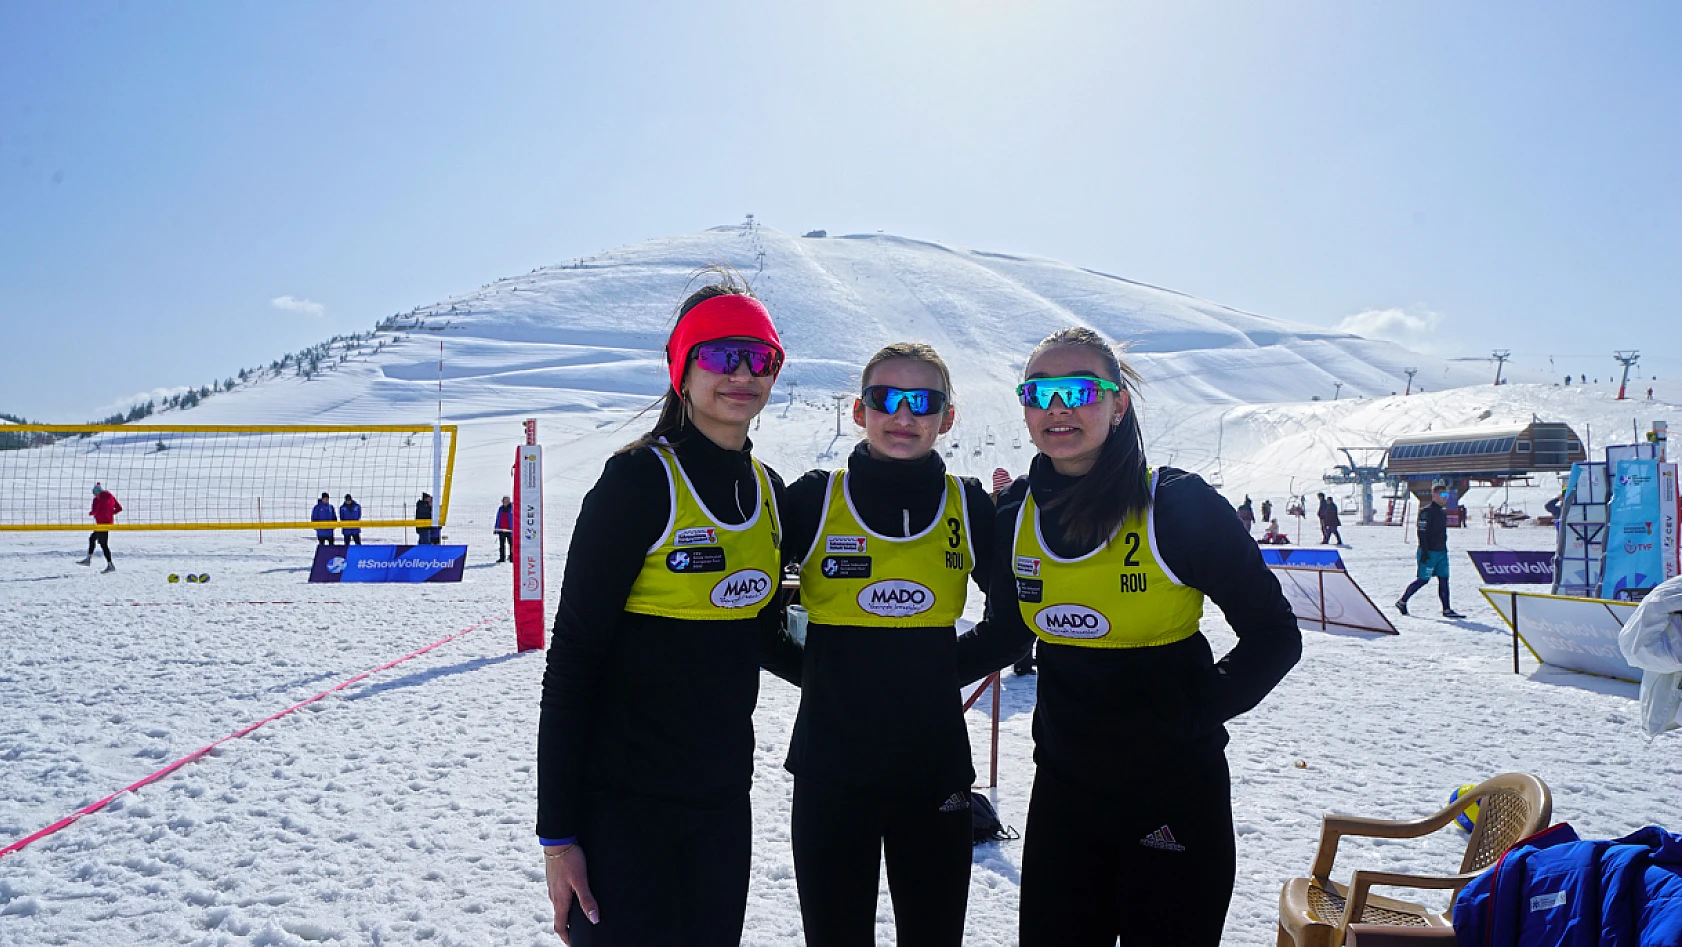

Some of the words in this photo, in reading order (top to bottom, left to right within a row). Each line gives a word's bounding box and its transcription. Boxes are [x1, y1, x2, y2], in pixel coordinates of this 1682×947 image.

[527, 504, 535, 526] CEV
[947, 517, 960, 548] 3
[1124, 532, 1140, 567] 2
[1637, 543, 1652, 551] TVF
[357, 558, 454, 570] #SnowVolleyball
[527, 556, 536, 576] TVF
[945, 551, 964, 570] ROU
[1666, 562, 1674, 580] TVF
[723, 577, 767, 597] MADO
[1120, 572, 1147, 593] ROU
[871, 588, 926, 604] MADO
[1046, 613, 1099, 629] MADO
